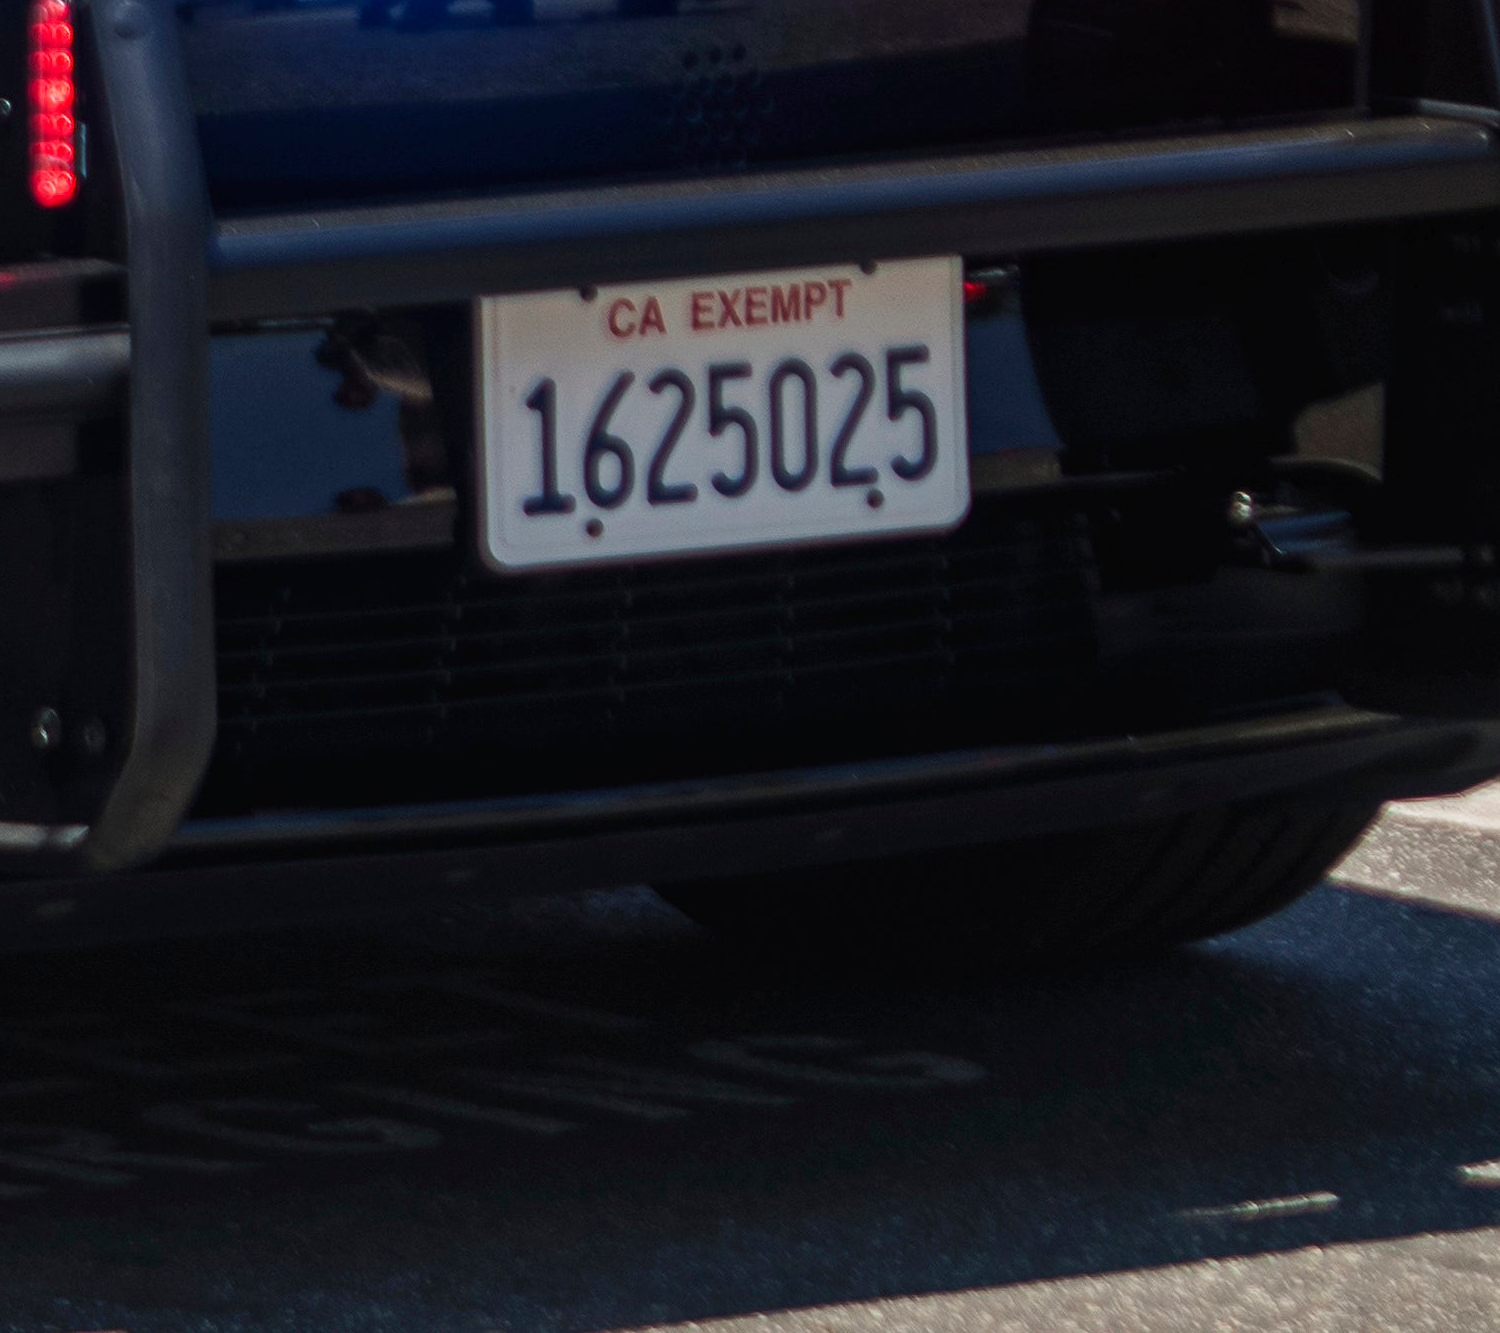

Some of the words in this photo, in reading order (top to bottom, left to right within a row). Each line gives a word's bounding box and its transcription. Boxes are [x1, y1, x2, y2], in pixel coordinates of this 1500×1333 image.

[607, 296, 668, 340] CA
[690, 278, 853, 332] EXEMPT
[522, 343, 939, 517] 1625025
